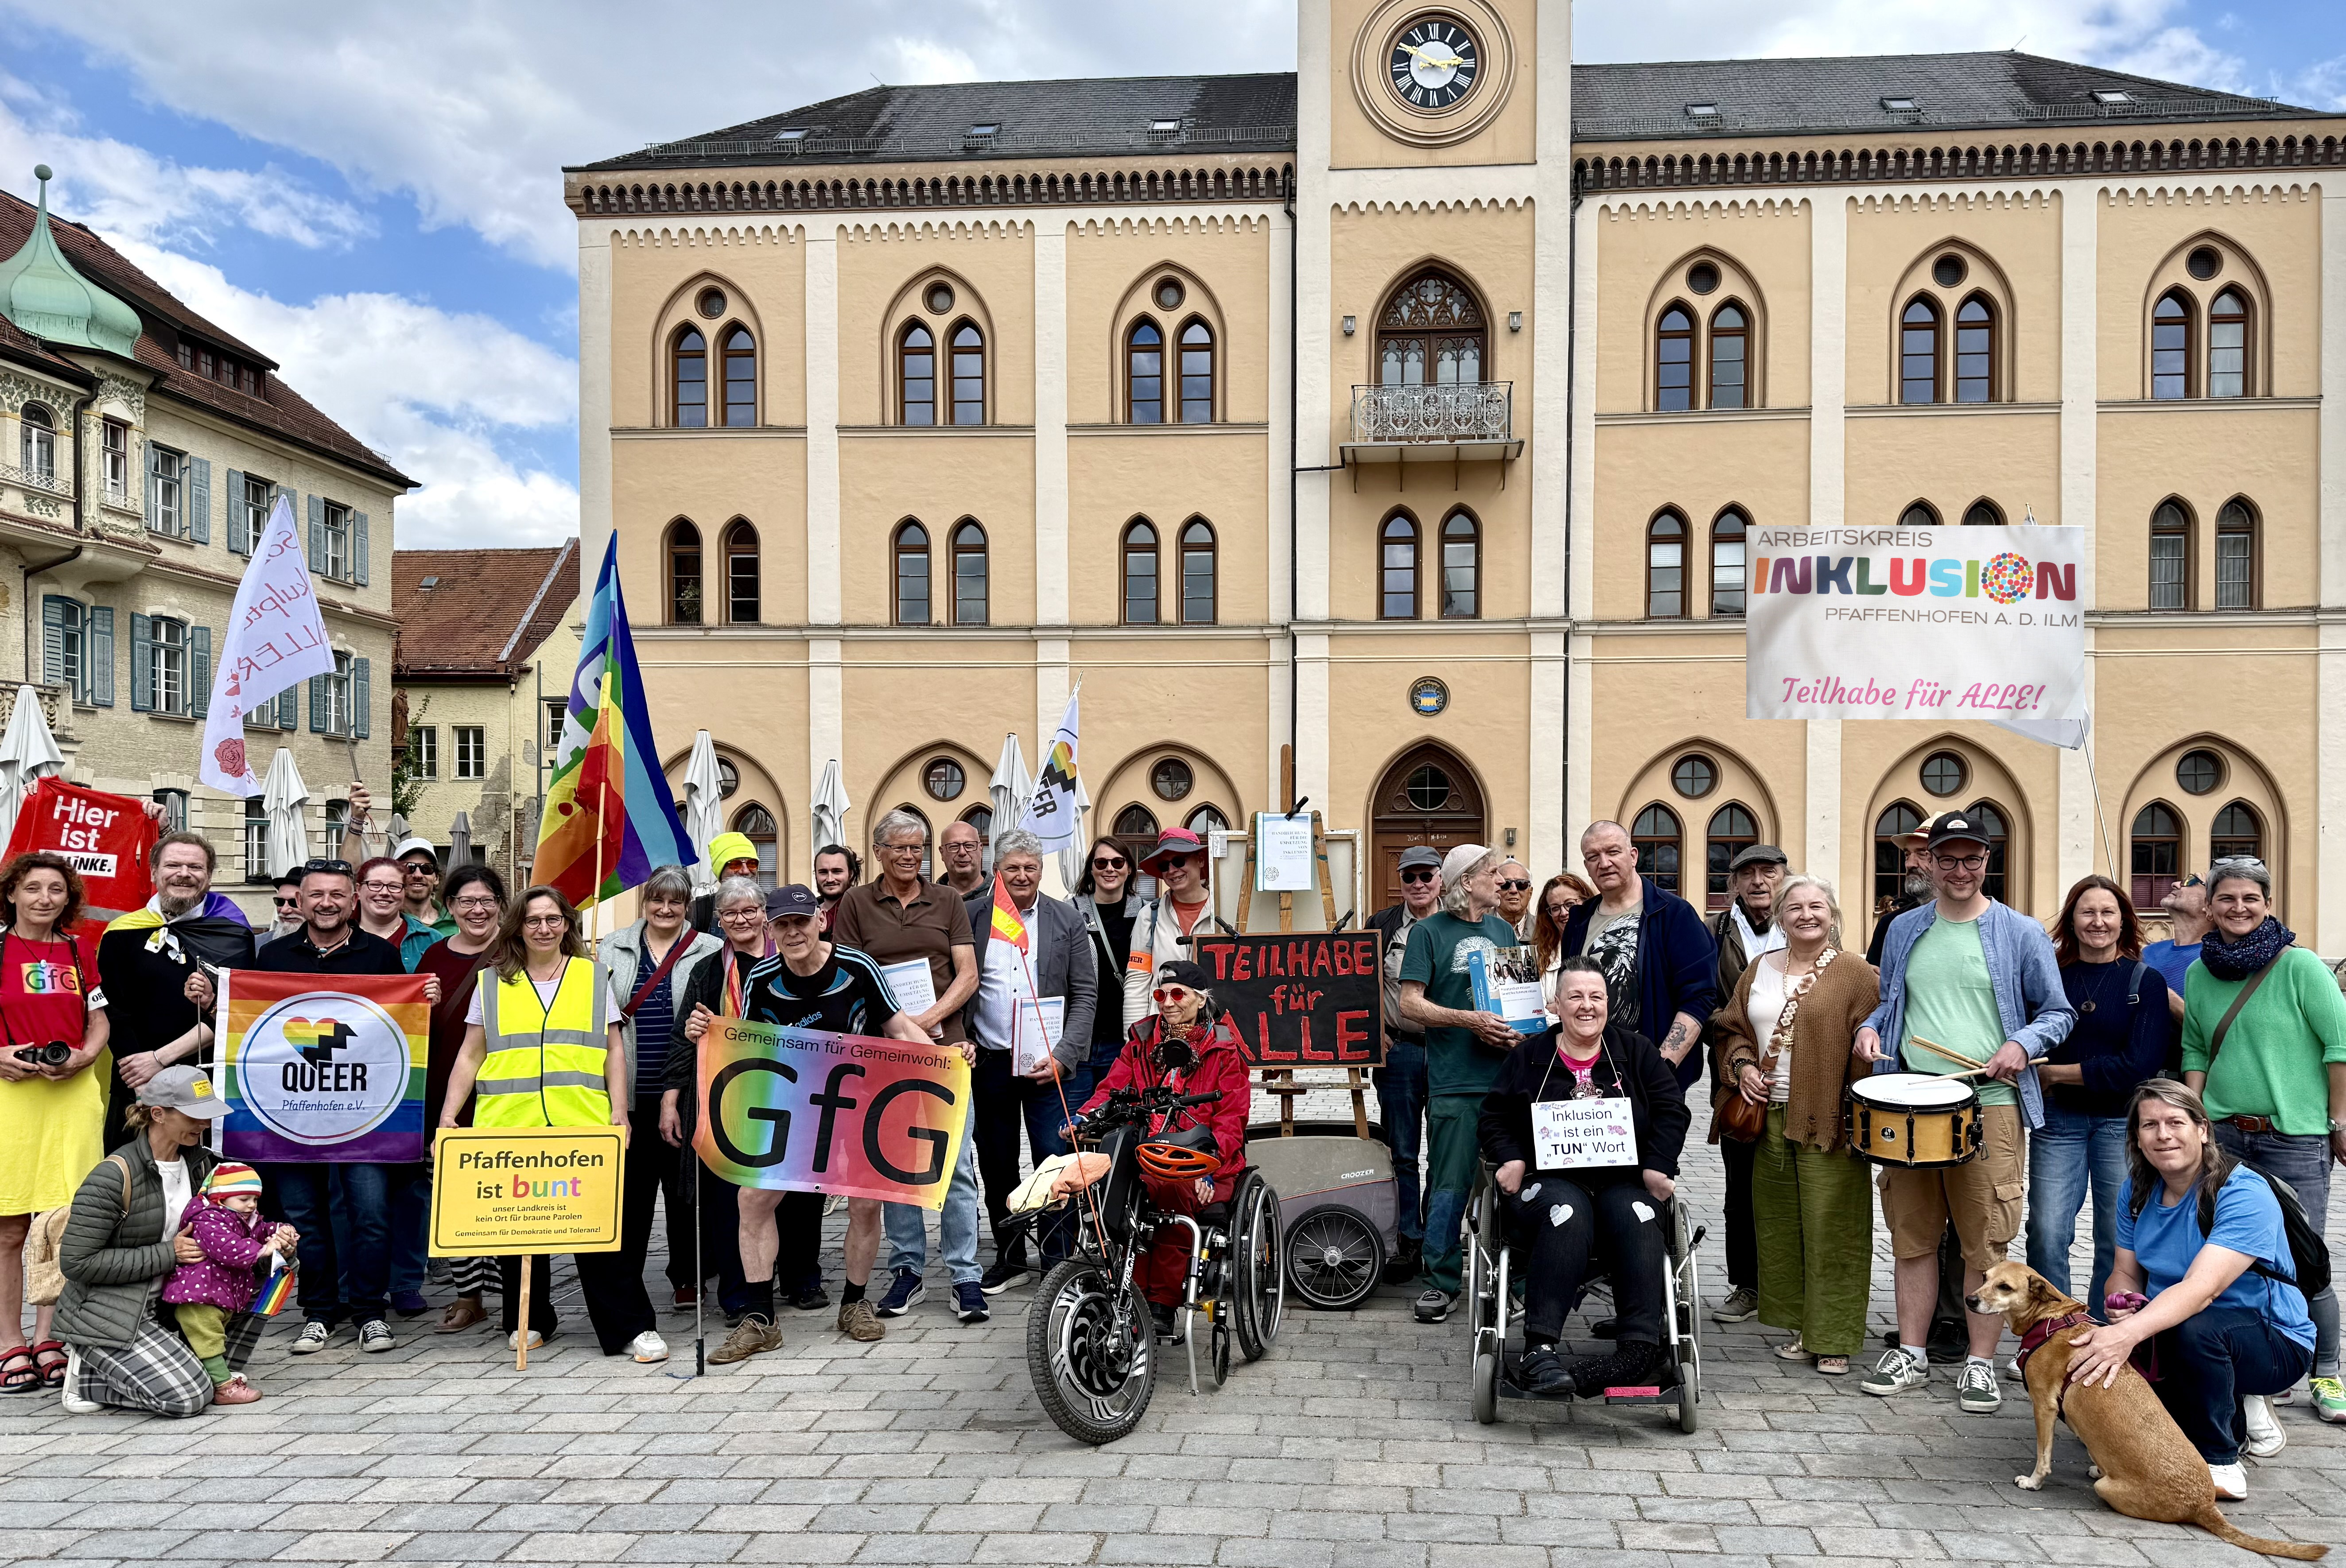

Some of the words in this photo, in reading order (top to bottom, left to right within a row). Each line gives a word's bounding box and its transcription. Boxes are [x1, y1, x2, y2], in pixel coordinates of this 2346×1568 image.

[1757, 530, 1933, 547] ARBEITSKREIS
[1753, 552, 2076, 605] INKLUSION
[1825, 608, 1988, 625] PFAFFENHOFEN
[1994, 612, 2012, 625] A.
[2019, 613, 2037, 626] D.
[2044, 614, 2078, 627] ILM
[1782, 676, 1896, 706] Teilhabe
[1904, 678, 1952, 710] für
[1957, 683, 2046, 710] ALLE!
[53, 795, 119, 828] Hier
[60, 823, 100, 851] ist
[1202, 940, 1374, 981] TEILHABE
[26, 969, 77, 991] GfG
[1269, 982, 1324, 1016] für
[795, 1012, 822, 1028] adidas
[1220, 1008, 1370, 1061] ALLE
[724, 1027, 820, 1052] Gemeinsam
[825, 1040, 846, 1055] für
[850, 1044, 952, 1070] Gemeinwohl:
[282, 1061, 367, 1093] QUEER
[282, 1099, 344, 1111] Pfaffenhofen
[347, 1100, 365, 1110] e.V.
[1552, 1108, 1612, 1122] Inklusion
[709, 1057, 955, 1185] GfG
[1564, 1126, 1580, 1138] ist
[1584, 1125, 1604, 1137] ein
[459, 1149, 604, 1169] Pfaffenhofen
[1547, 1142, 1588, 1158] „TUN“
[1592, 1141, 1626, 1153] Wort
[1341, 1168, 1375, 1179] CROOZER
[477, 1181, 503, 1199] ist
[512, 1174, 582, 1199] bunt
